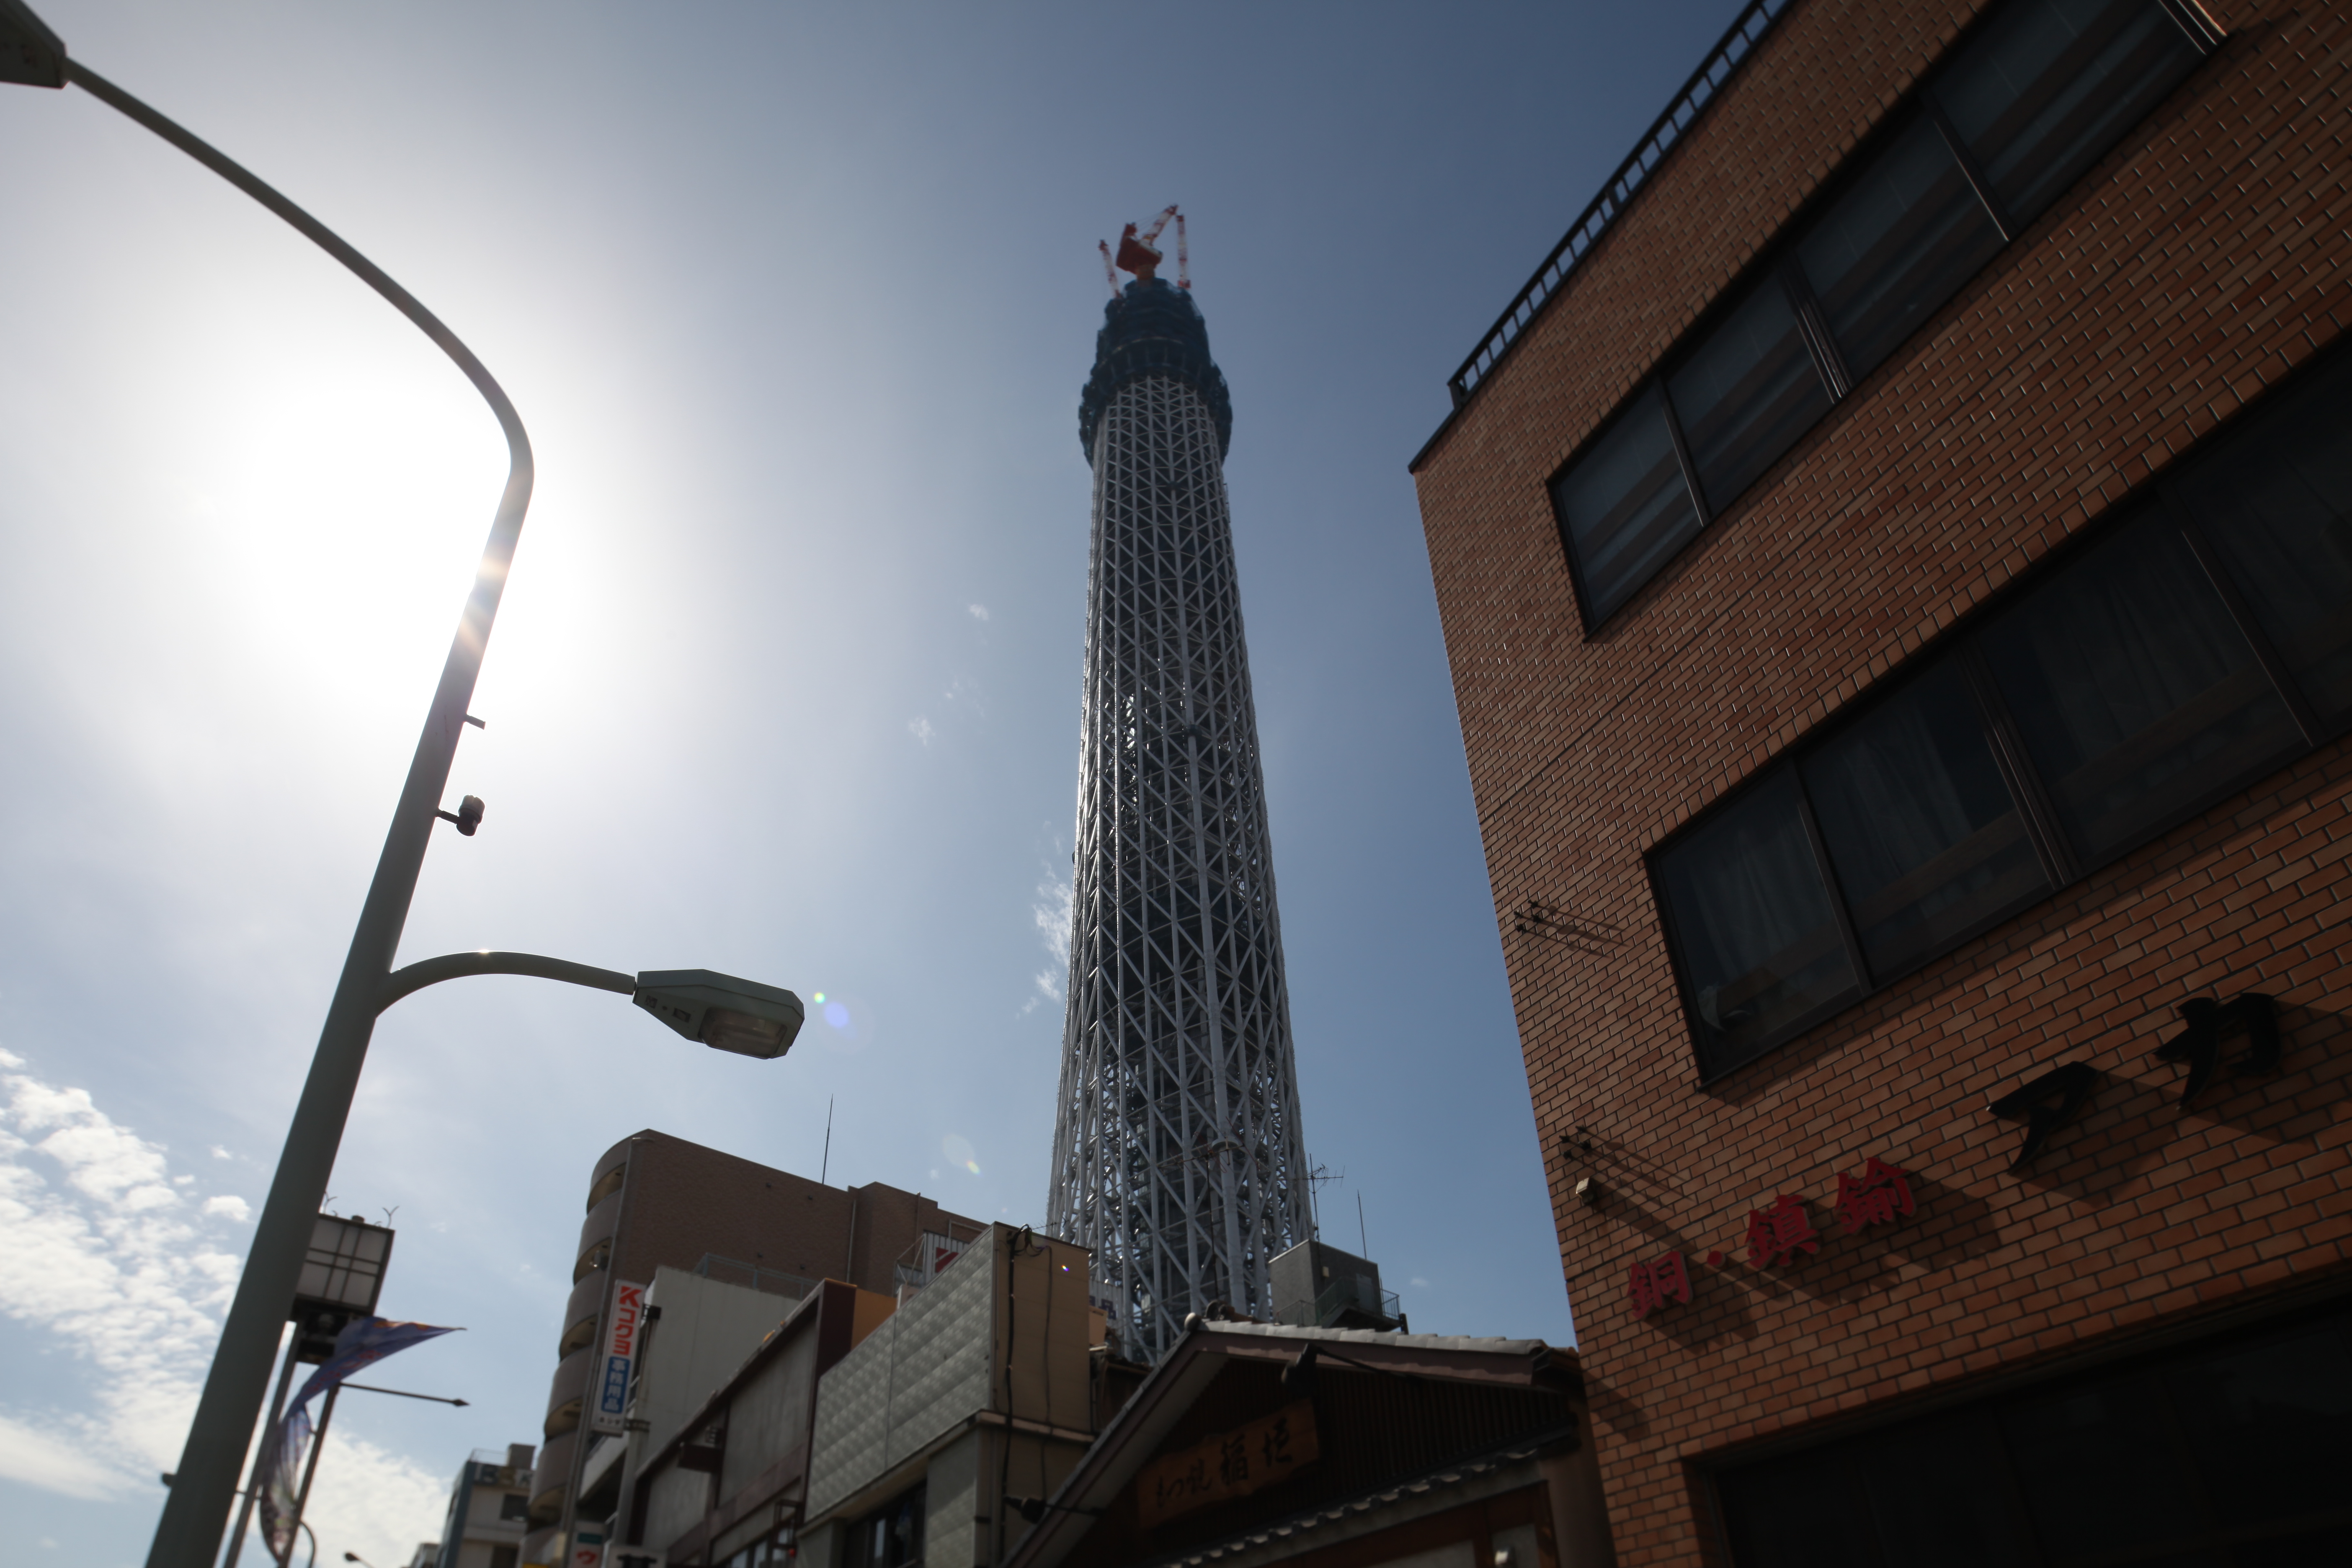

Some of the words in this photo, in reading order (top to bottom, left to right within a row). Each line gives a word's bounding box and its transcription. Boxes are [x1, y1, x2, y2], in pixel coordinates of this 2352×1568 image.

[613, 1308, 636, 1356] コクヨ
[604, 1359, 627, 1411] 事務用品
